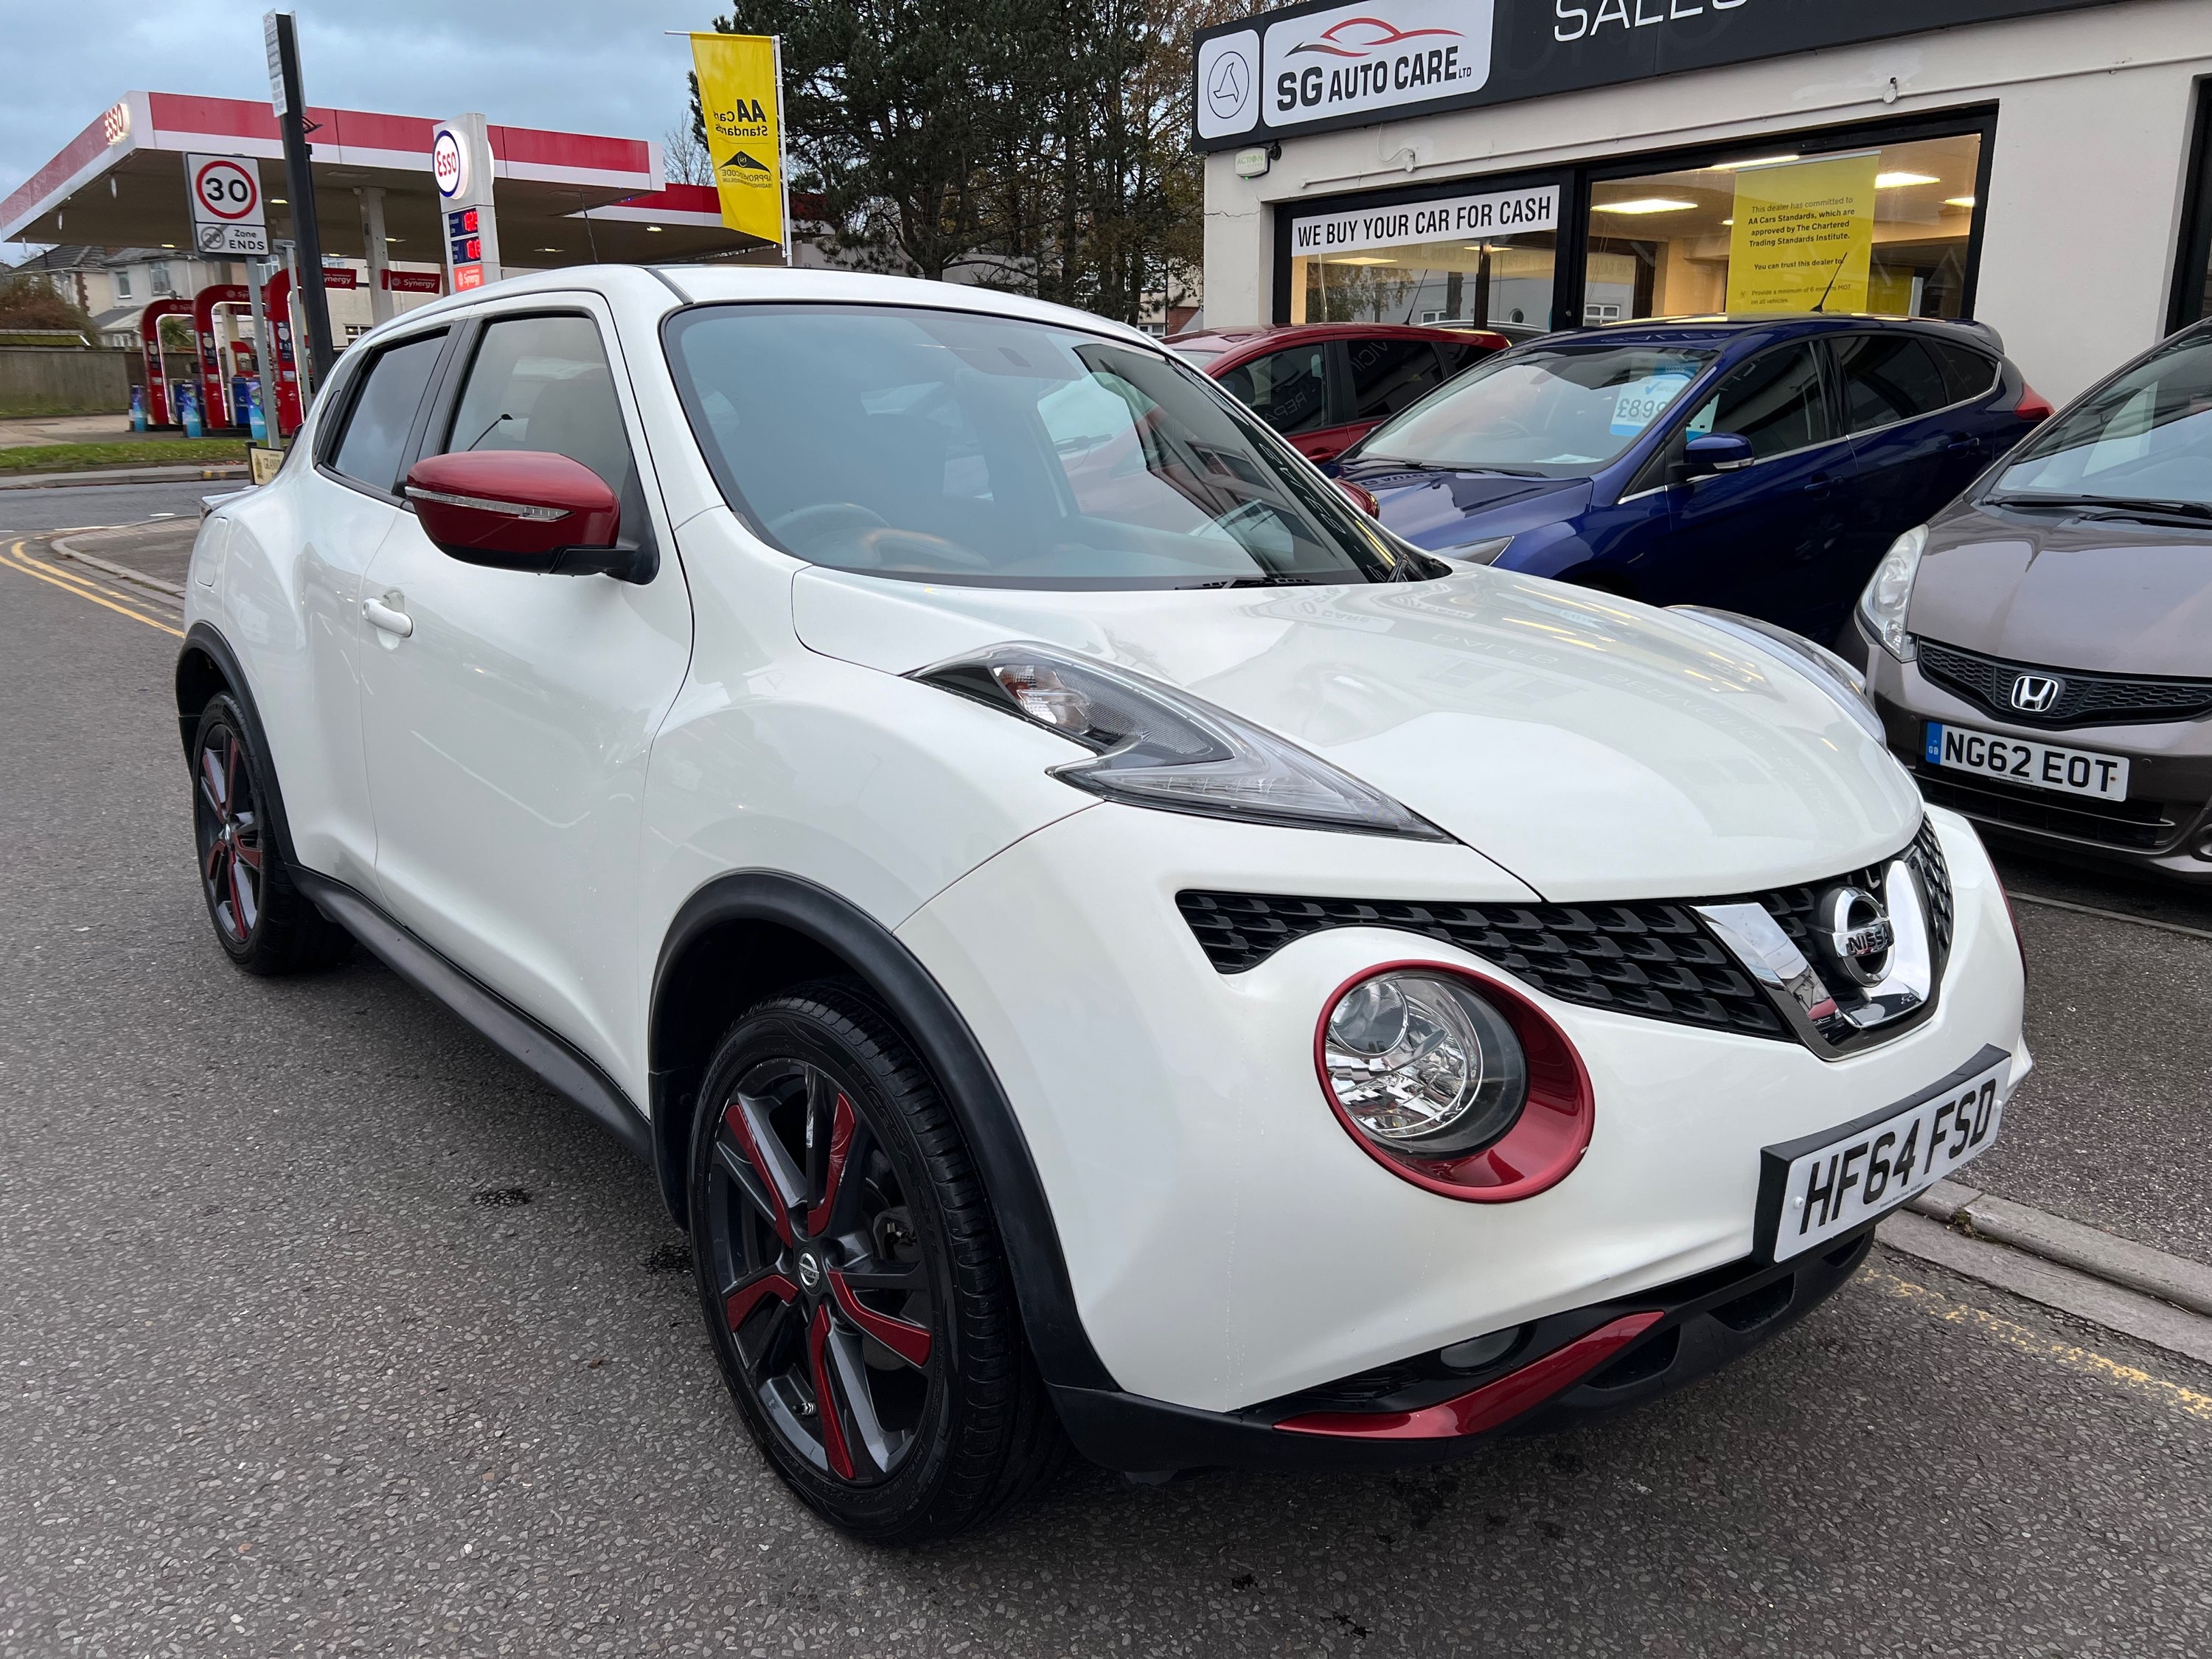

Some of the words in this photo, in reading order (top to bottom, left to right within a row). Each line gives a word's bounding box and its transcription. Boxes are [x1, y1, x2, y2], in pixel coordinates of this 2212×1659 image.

[1277, 66, 1323, 111] SG
[1329, 60, 1388, 102] AUTO
[1394, 46, 1458, 90] CARE
[1458, 66, 1472, 80] LTD
[1237, 155, 1264, 166] ACTION
[205, 178, 248, 202] 30
[1767, 204, 1789, 212] dealer
[1805, 197, 1844, 208] committed
[1298, 225, 1321, 247] WE
[1327, 220, 1357, 244] BUY
[1363, 215, 1409, 240] YOUR
[1416, 209, 1450, 234] CAR
[1457, 204, 1492, 229] FOR
[1500, 196, 1551, 225] CASH
[1778, 212, 1817, 222] Standards,
[1819, 209, 1841, 218] which
[234, 229, 257, 237] Zone
[1751, 226, 1785, 236] approved
[1812, 220, 1850, 230] Chartered
[229, 240, 265, 251] ENDS
[1778, 235, 1814, 245] Standards
[1816, 233, 1850, 241] Institute.
[323, 276, 352, 285] ynergy
[403, 279, 435, 288] Synergy
[1929, 745, 1938, 755] GB
[1945, 731, 2032, 778] NG62
[2042, 750, 2118, 793] EOT
[1799, 1118, 1921, 1236] HF64
[1923, 1078, 1996, 1176] FSD
